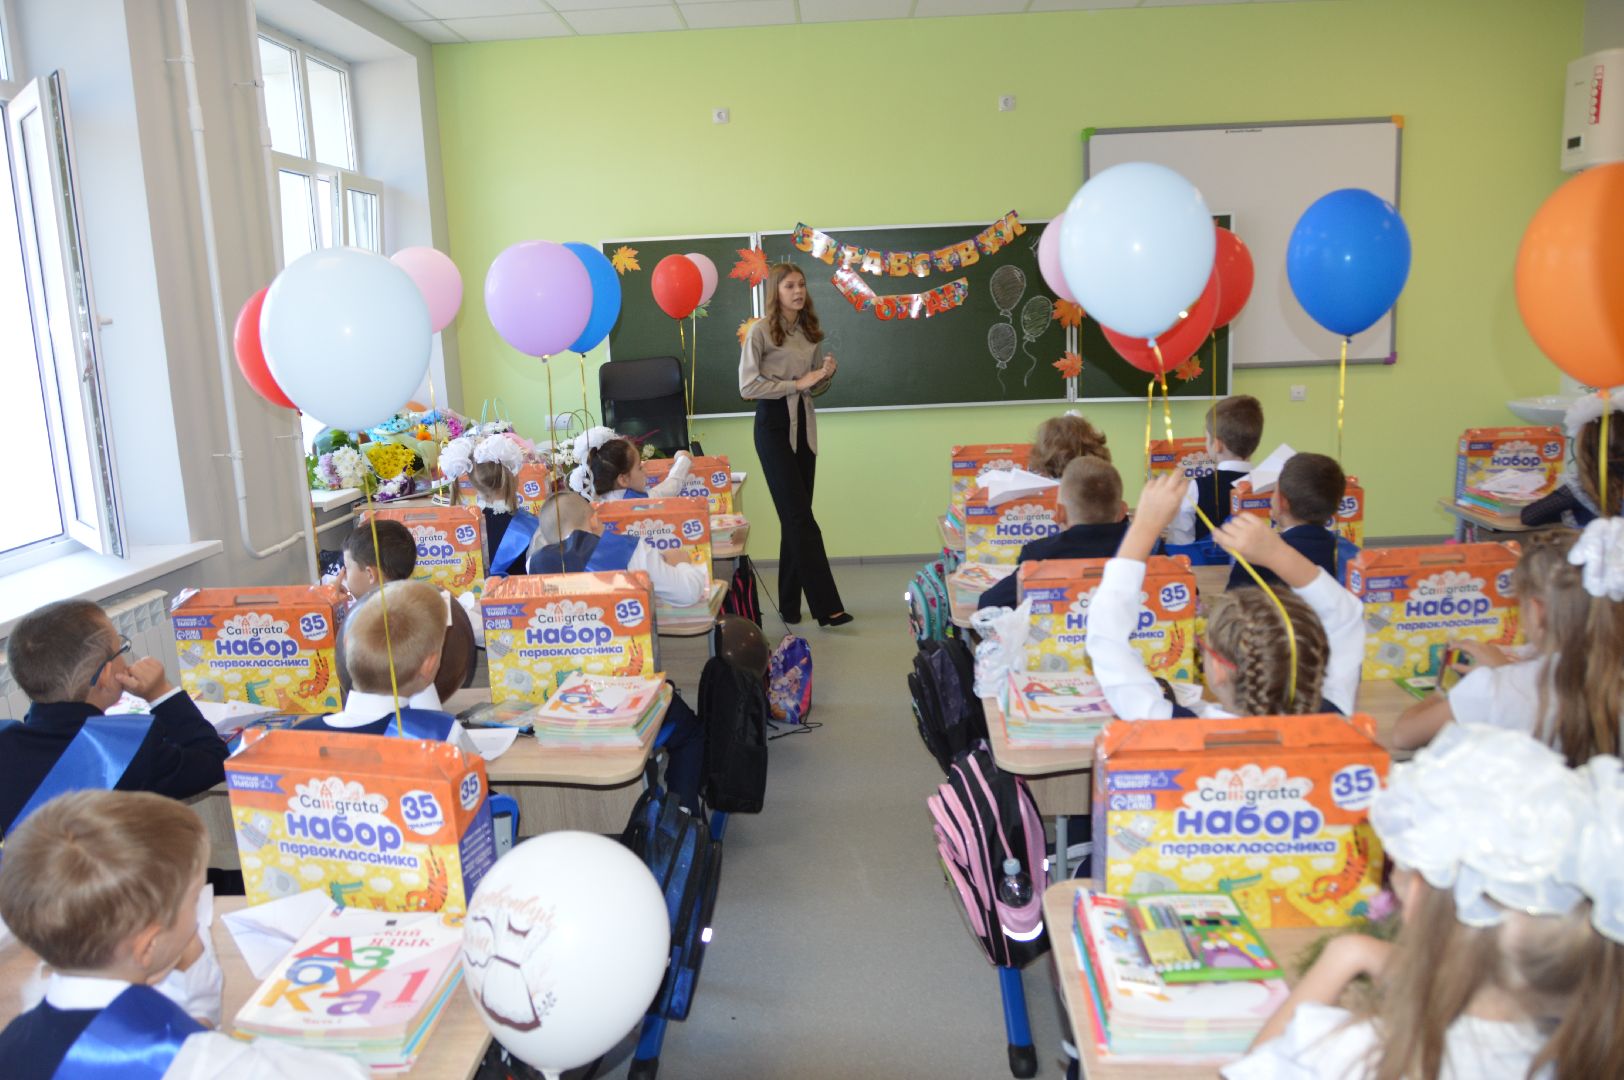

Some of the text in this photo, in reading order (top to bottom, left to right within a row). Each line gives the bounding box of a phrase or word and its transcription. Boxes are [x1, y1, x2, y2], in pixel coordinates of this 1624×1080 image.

[524, 482, 538, 493] 35
[711, 472, 726, 484] 35
[456, 525, 475, 539] 35
[683, 520, 702, 535] 35
[417, 543, 454, 558] бор
[1160, 584, 1187, 604] 35
[615, 600, 642, 619] 35
[1406, 597, 1490, 617] набор
[300, 614, 326, 633] 35
[526, 625, 613, 646] набор
[216, 637, 299, 659] набор
[519, 646, 624, 659] первоклассника
[209, 658, 310, 670] первоклассника
[460, 773, 479, 800] 35
[1333, 768, 1376, 797] 35
[401, 794, 439, 821] 35
[1177, 804, 1321, 840] набор
[286, 813, 403, 853] набор
[279, 841, 420, 869] первоклассника
[1161, 840, 1338, 858] первоклассника
